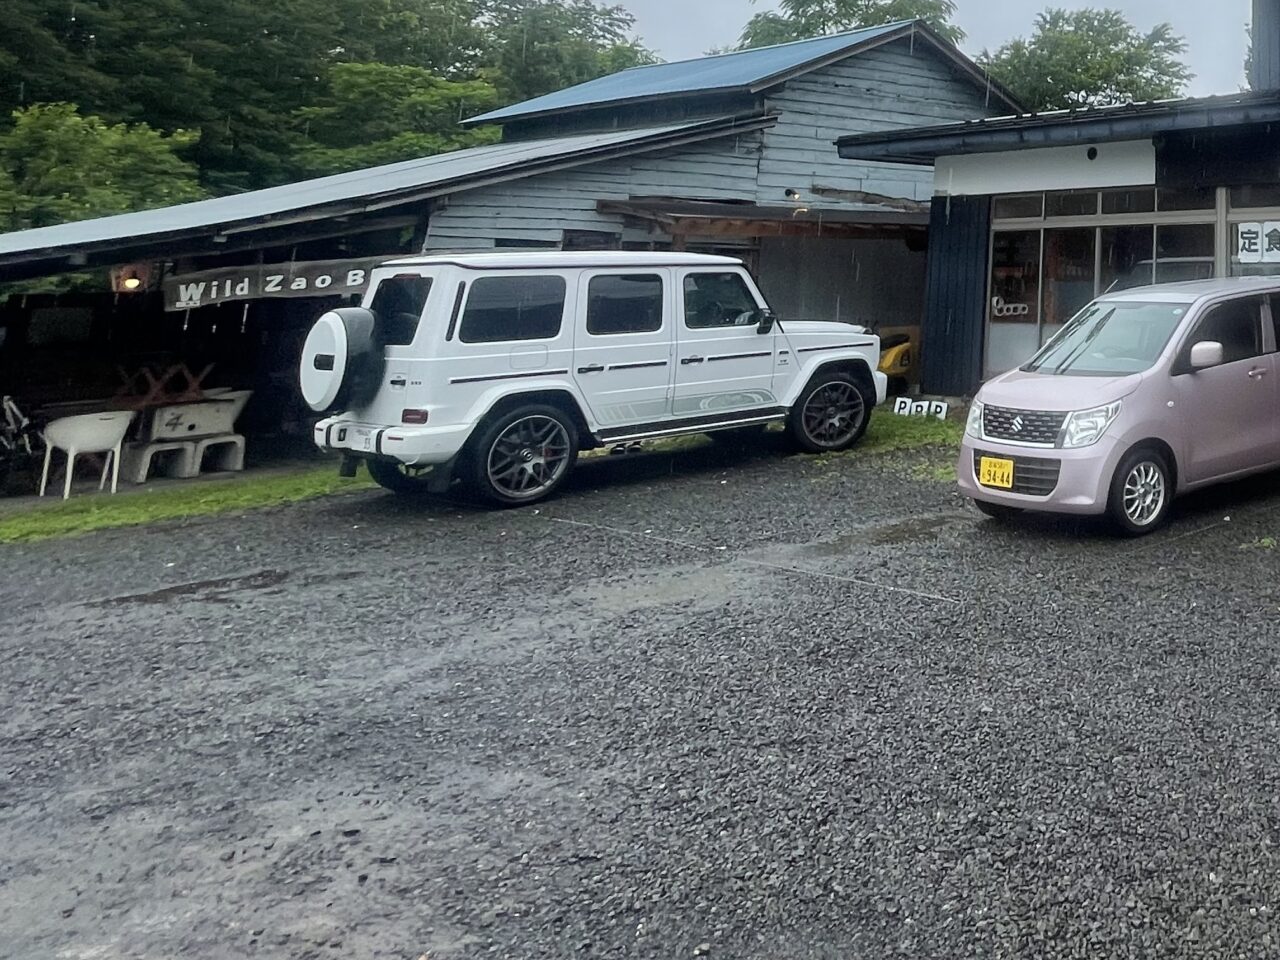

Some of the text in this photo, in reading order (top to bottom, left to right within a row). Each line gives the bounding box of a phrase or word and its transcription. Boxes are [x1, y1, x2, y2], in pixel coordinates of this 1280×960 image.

[179, 277, 249, 302] Wild
[264, 274, 333, 292] Zao
[898, 400, 907, 414] P
